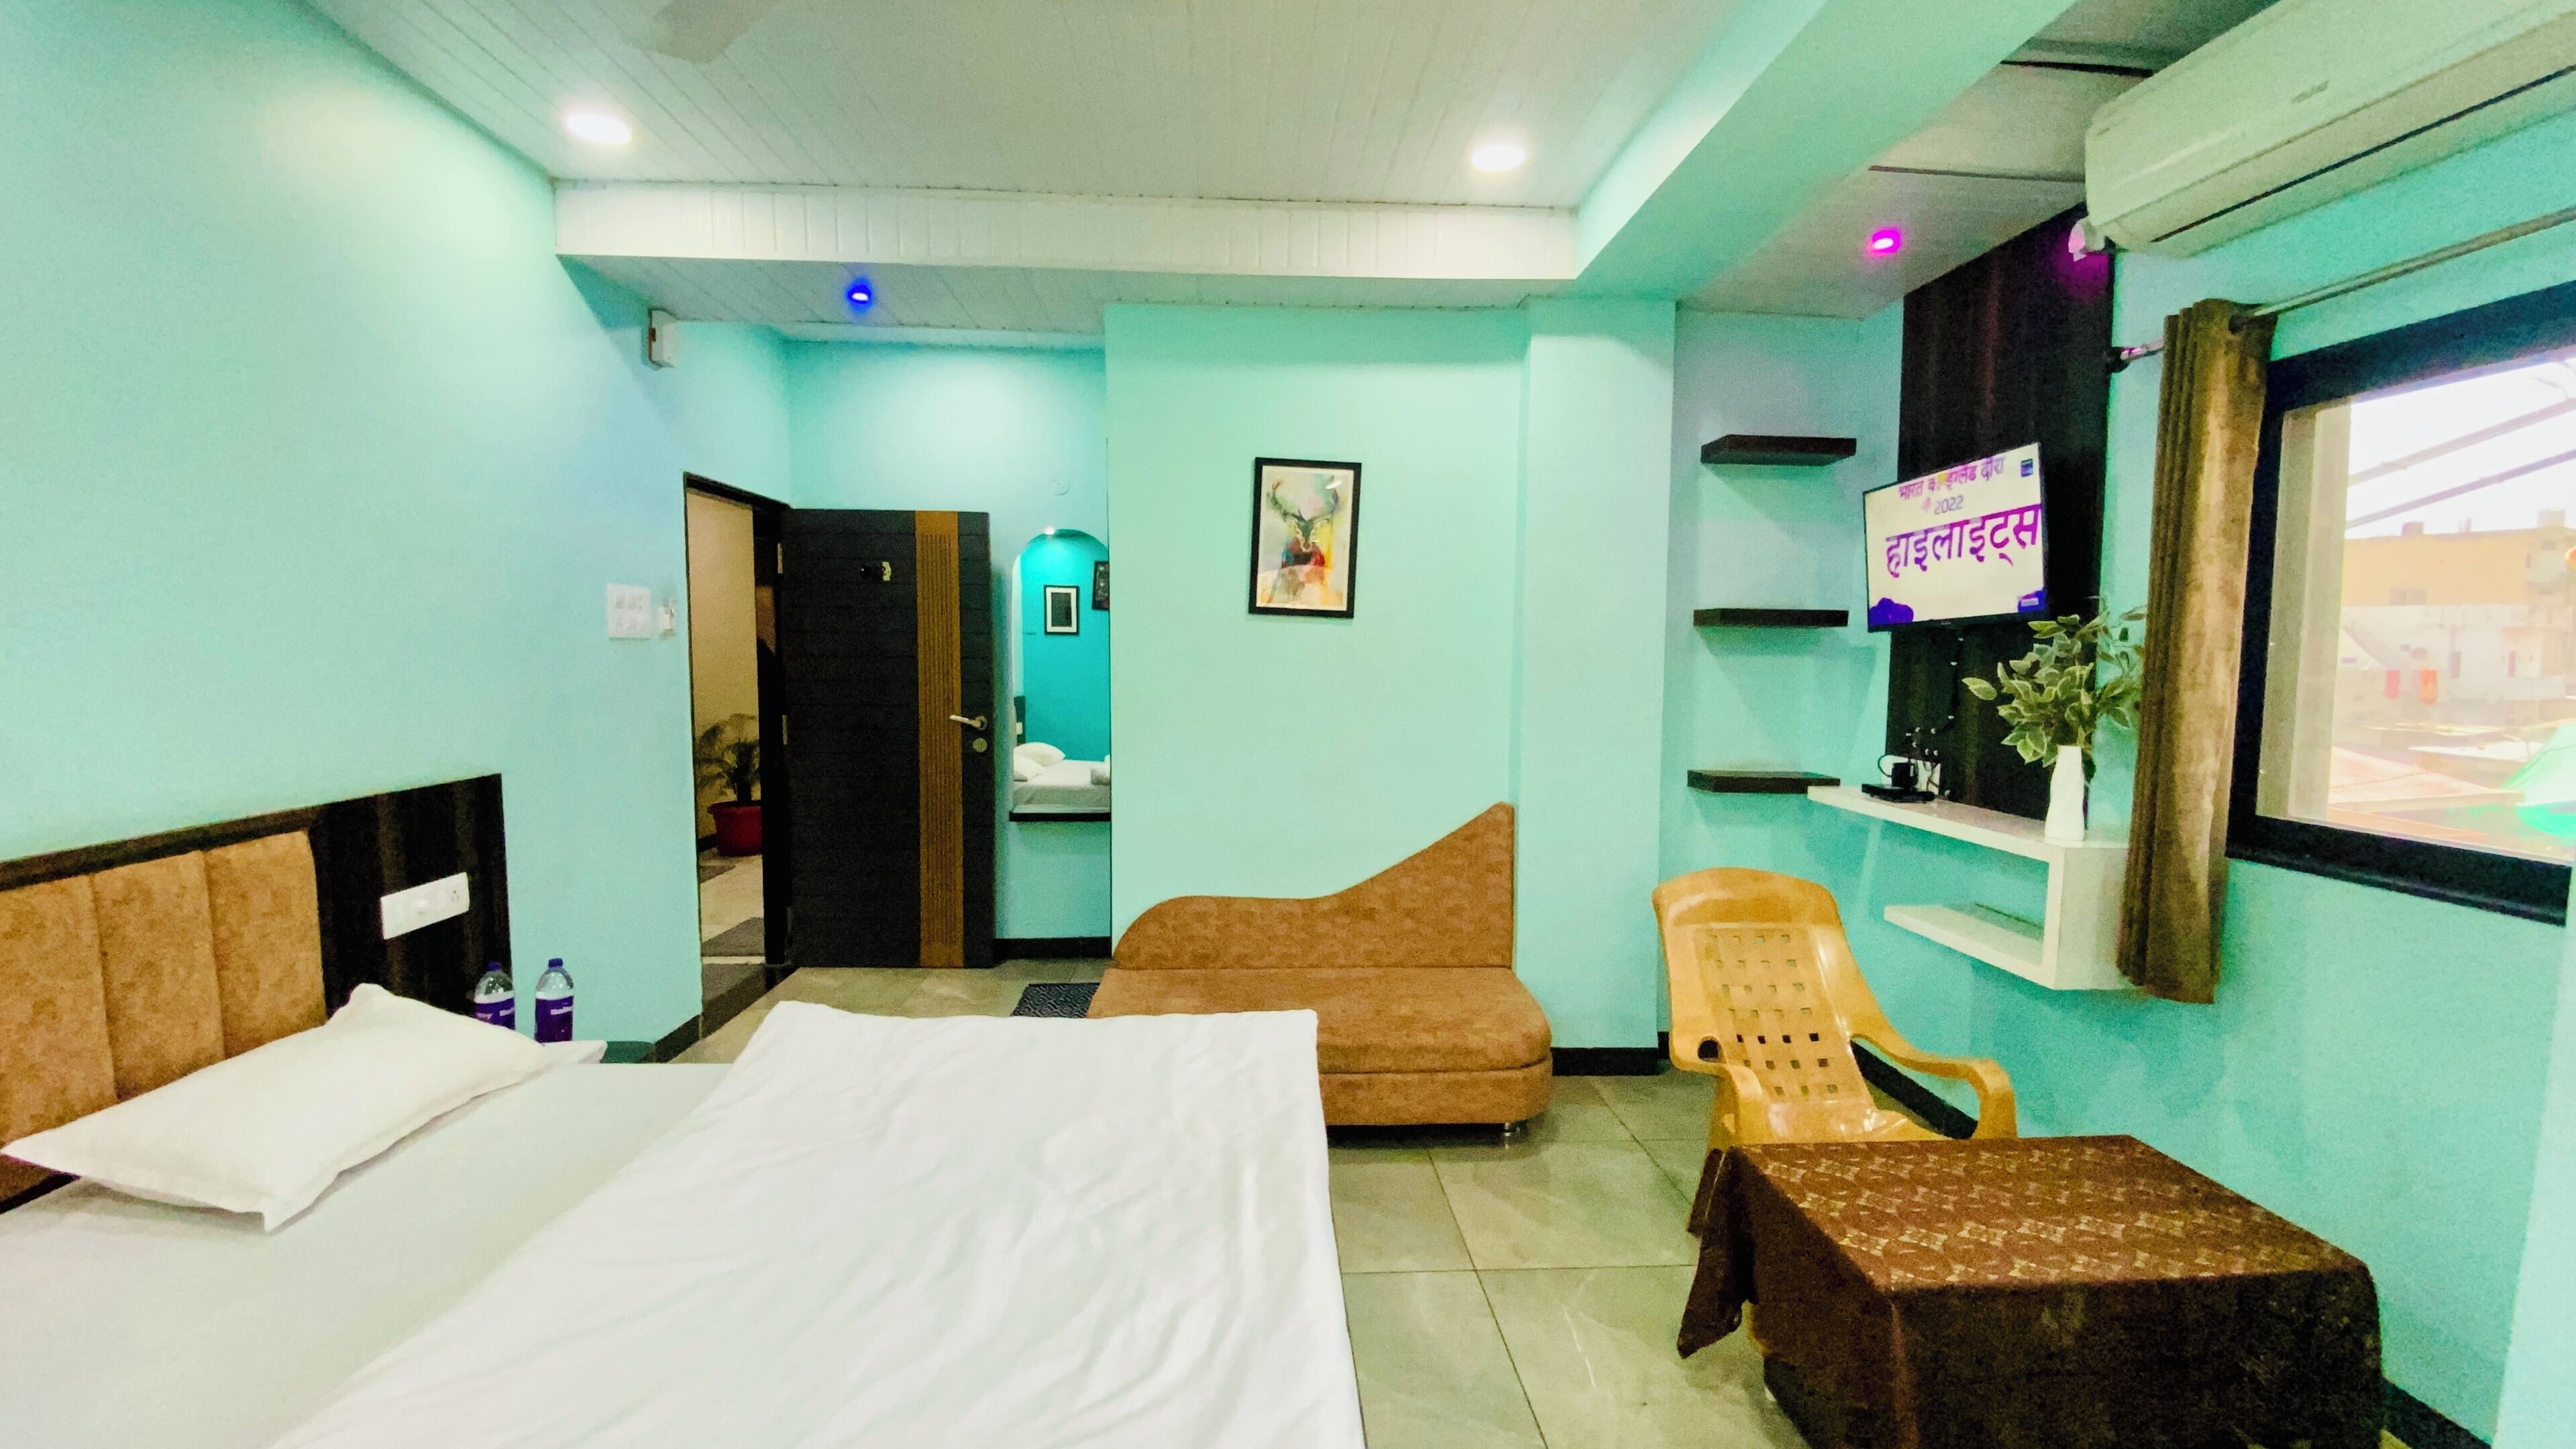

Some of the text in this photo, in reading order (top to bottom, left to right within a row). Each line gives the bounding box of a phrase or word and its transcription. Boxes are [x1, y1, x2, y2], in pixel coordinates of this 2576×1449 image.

[1898, 480, 1924, 500] भारत
[1934, 495, 1964, 515] 2022
[1886, 504, 2042, 578] हाइलाइट्स
